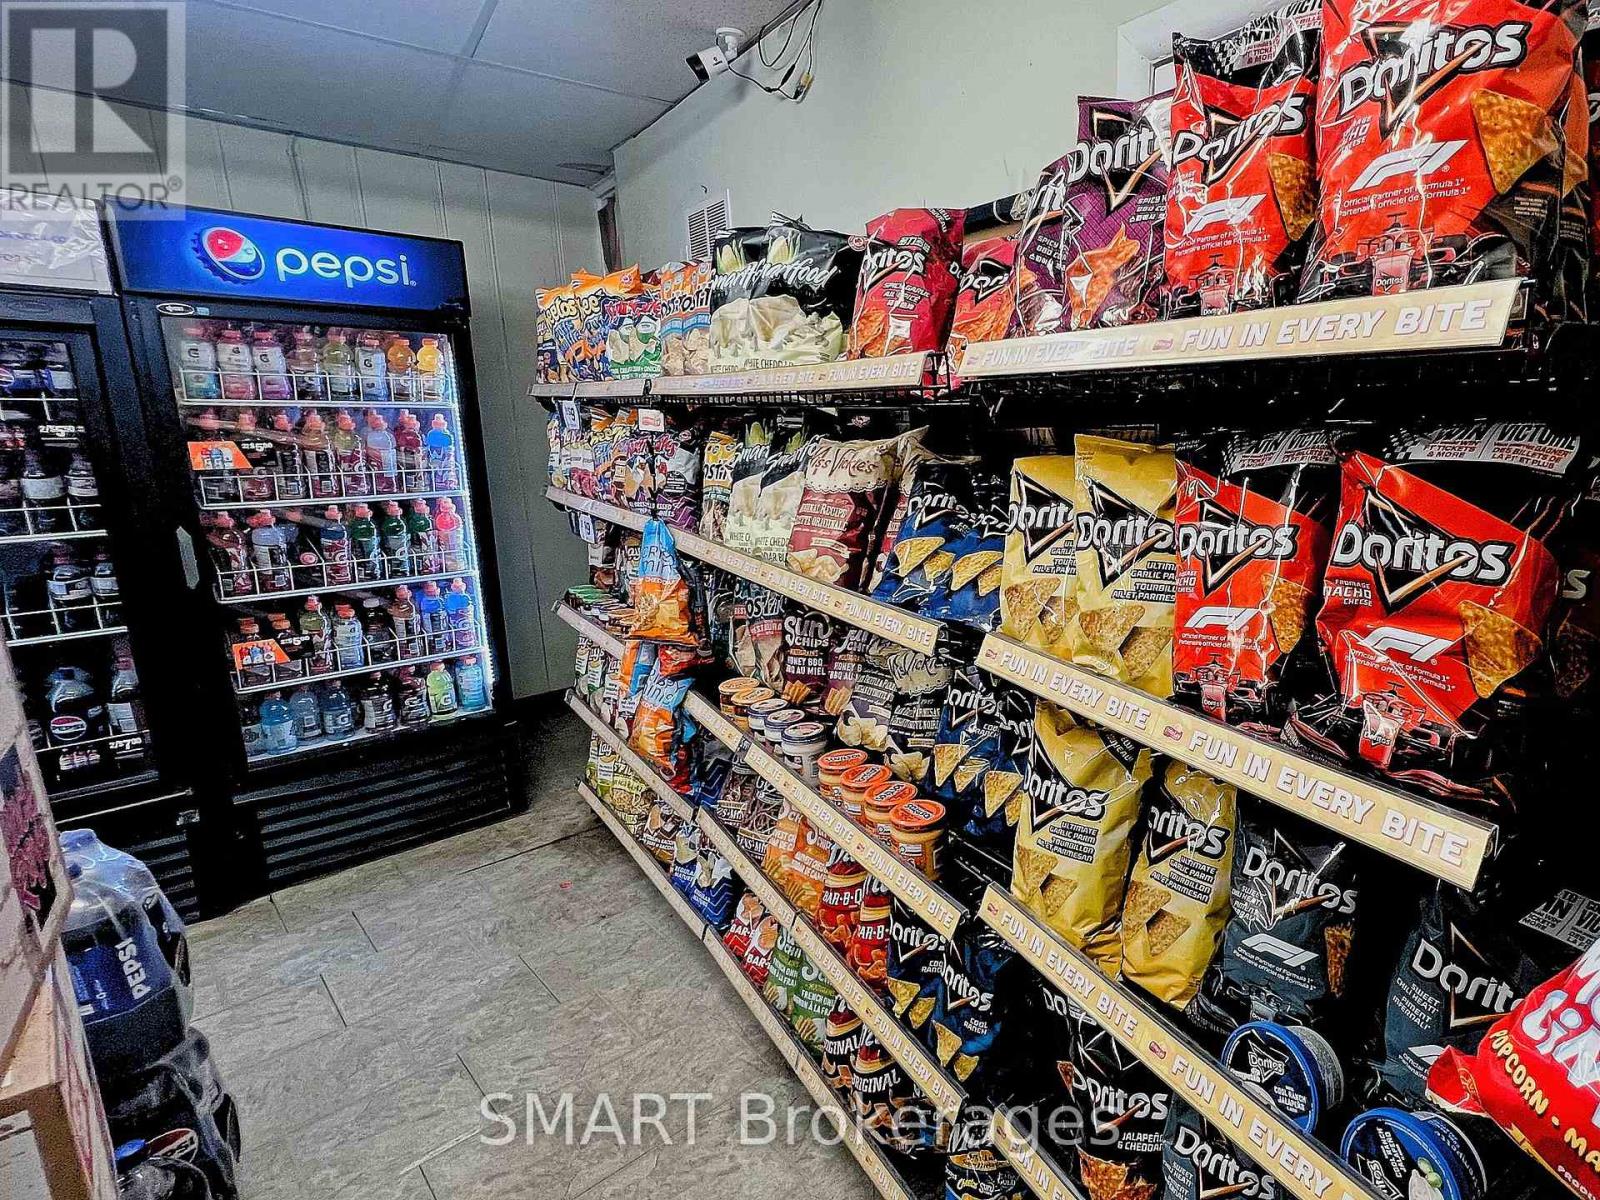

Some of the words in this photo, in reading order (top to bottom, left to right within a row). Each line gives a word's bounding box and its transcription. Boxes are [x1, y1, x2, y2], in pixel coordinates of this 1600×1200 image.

[1341, 24, 1525, 116] Doritos
[1173, 97, 1306, 164] Doritos
[1068, 126, 1166, 183] Dorit
[276, 246, 411, 288] pepsi
[983, 346, 1011, 367] FUN
[1014, 344, 1030, 364] IN
[1097, 336, 1142, 359] BITE
[1181, 319, 1234, 353] FUN
[1240, 318, 1269, 348] IN
[1277, 307, 1390, 345] EVERY
[1395, 298, 1491, 336] BITE
[892, 362, 916, 378] BITE
[1514, 448, 1549, 461] BILLETS
[1179, 523, 1294, 558] Doritos
[1334, 522, 1510, 581] Doritos
[1135, 583, 1176, 592] TOURBILL
[1137, 592, 1175, 602] PARMES
[1323, 586, 1372, 600] NACHO
[794, 638, 829, 648] CHIPS
[873, 614, 907, 637] EVERY
[907, 627, 933, 647] BITE
[807, 667, 826, 677] MIEL
[1353, 649, 1376, 662] Official
[1414, 666, 1441, 680] Formula
[1419, 676, 1446, 690] Formula
[1001, 650, 1028, 679] FUN
[1032, 665, 1047, 686] IN
[1050, 672, 1102, 707] EVERY
[1105, 695, 1149, 731] BITE
[1187, 730, 1237, 770] FUN
[1242, 752, 1272, 784] IN
[1276, 766, 1379, 824] EVERY
[1382, 809, 1470, 867] BITE
[1062, 821, 1097, 836] ULTIMATE
[1150, 808, 1225, 857] oritos
[1243, 846, 1358, 914] Doritos
[928, 896, 954, 927] BITE
[115, 937, 152, 1001] PEPSI
[1412, 937, 1523, 1013] Dorit
[1410, 982, 1441, 1006] SWEET
[1000, 911, 1028, 940] FUN
[1028, 933, 1046, 953] IN
[1046, 951, 1096, 1000] EVERY
[1096, 991, 1140, 1040] BITE
[1171, 1053, 1217, 1104] FUN
[1219, 1092, 1246, 1129] IN
[1247, 1115, 1333, 1198] EVERY
[1174, 1125, 1276, 1200] Doritos
